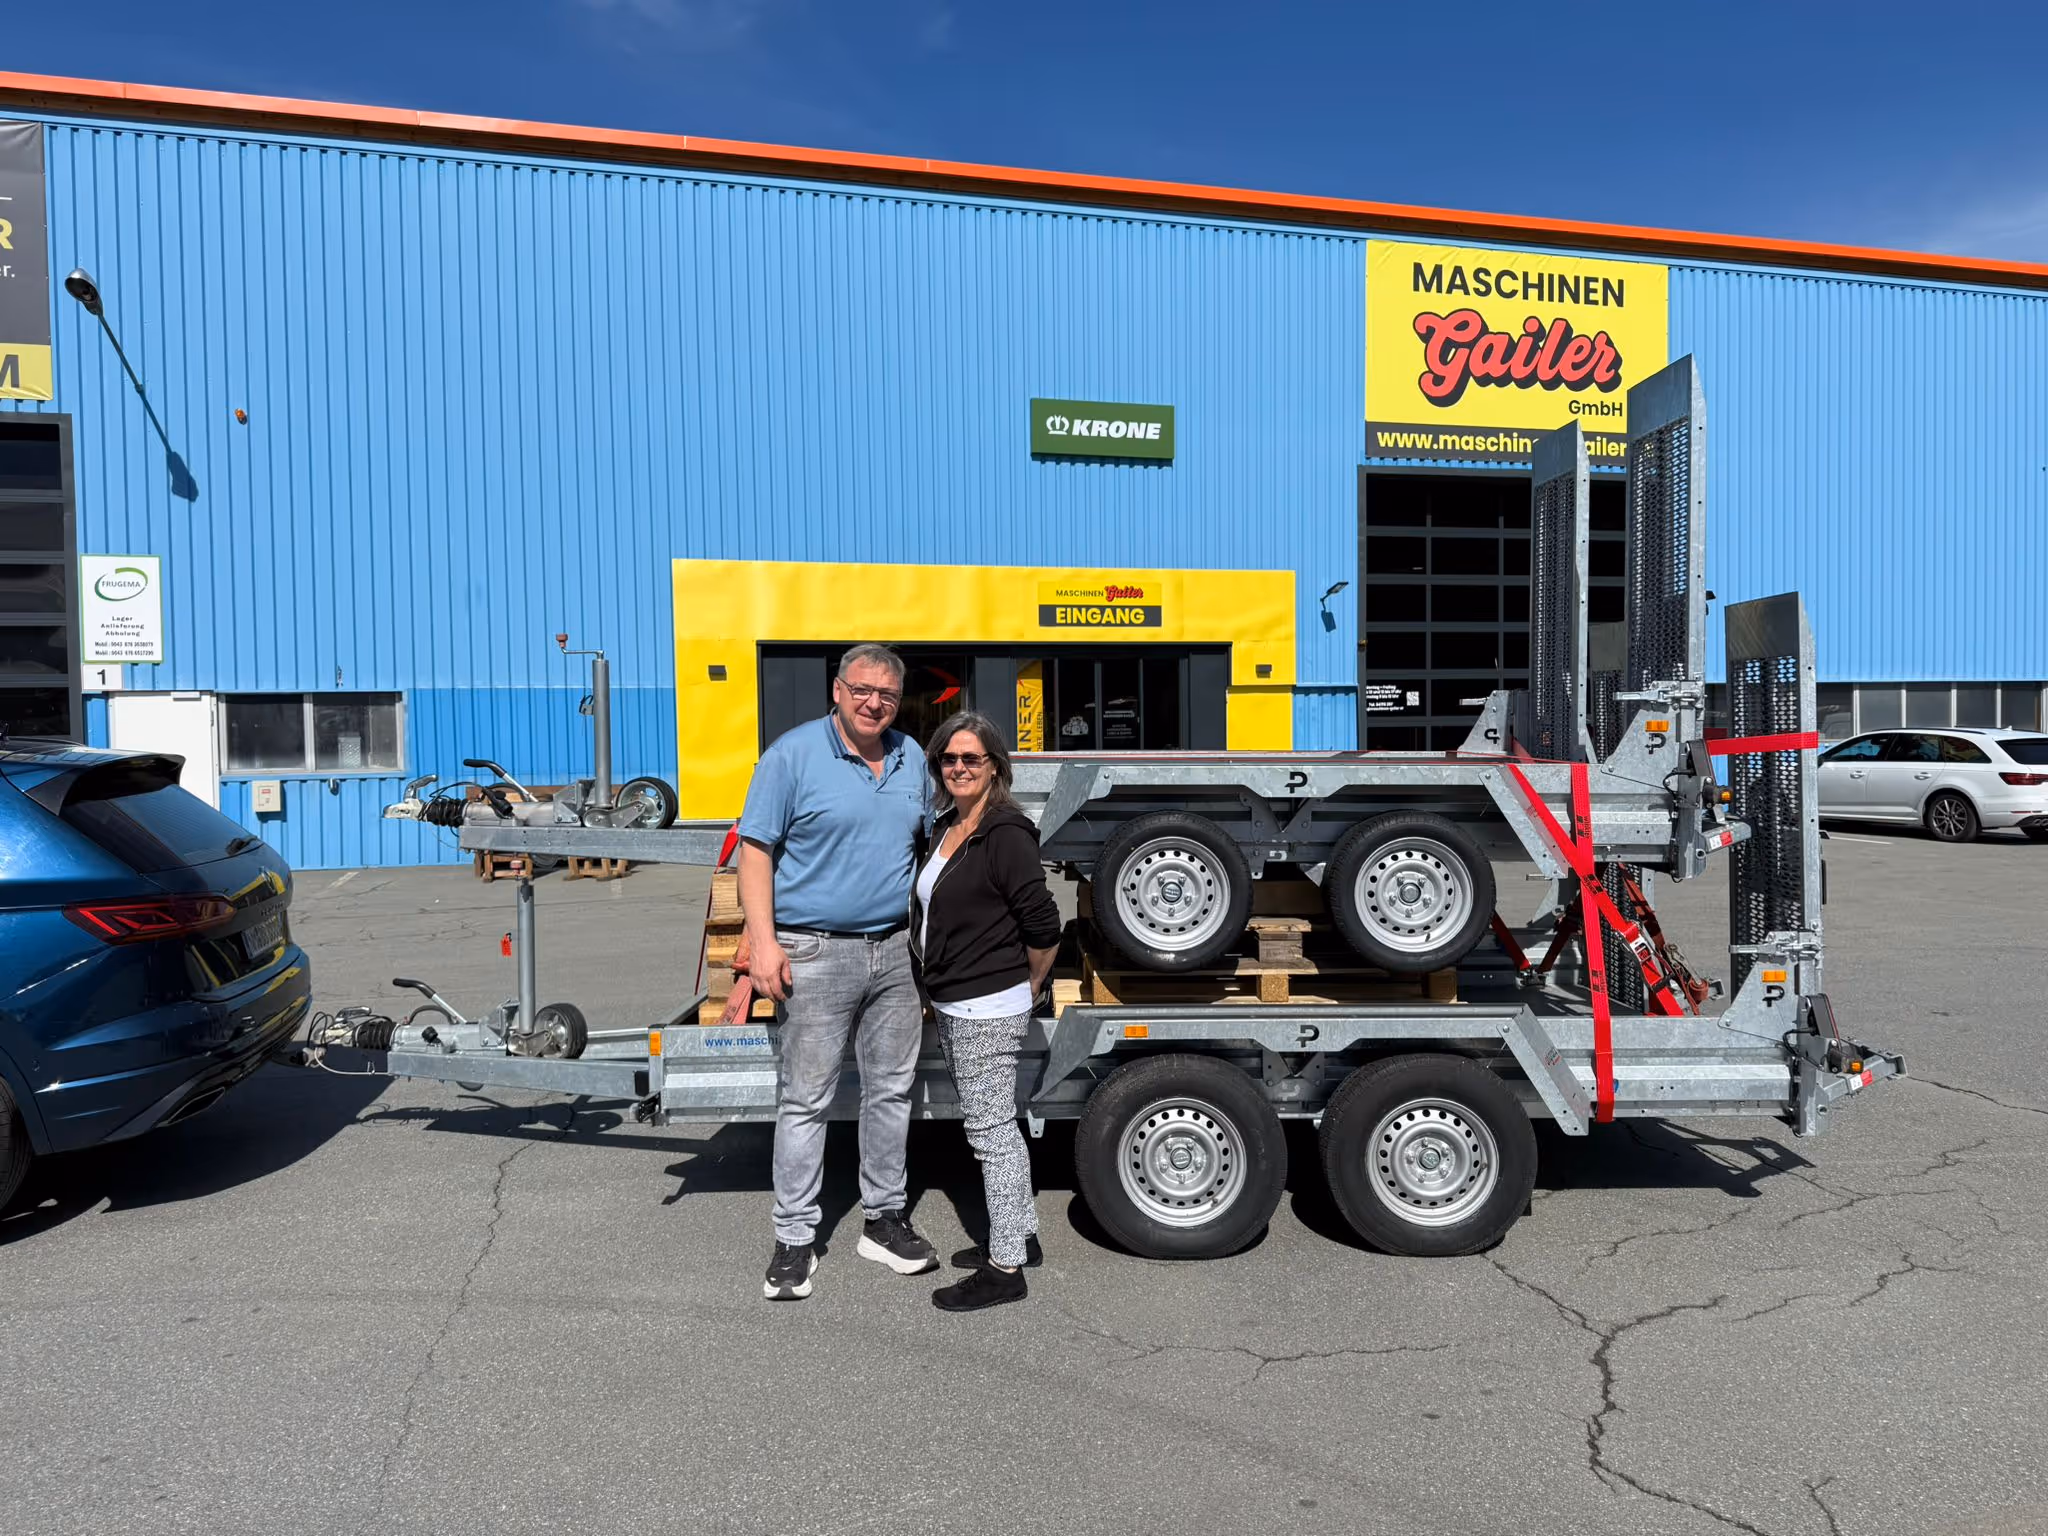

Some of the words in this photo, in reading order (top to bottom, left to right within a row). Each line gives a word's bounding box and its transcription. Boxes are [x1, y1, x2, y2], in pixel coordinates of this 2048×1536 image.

[1412, 262, 1625, 307] MASCHINEN
[1413, 308, 1623, 408] Gailer
[1568, 400, 1624, 417] GmbH
[1072, 419, 1162, 440] KRONE
[102, 580, 141, 588] FRUGEMA
[1056, 589, 1104, 598] MASCHINEN
[1056, 607, 1145, 624] EINGANG
[97, 669, 106, 685] 1
[705, 1034, 779, 1046] www.maschi
